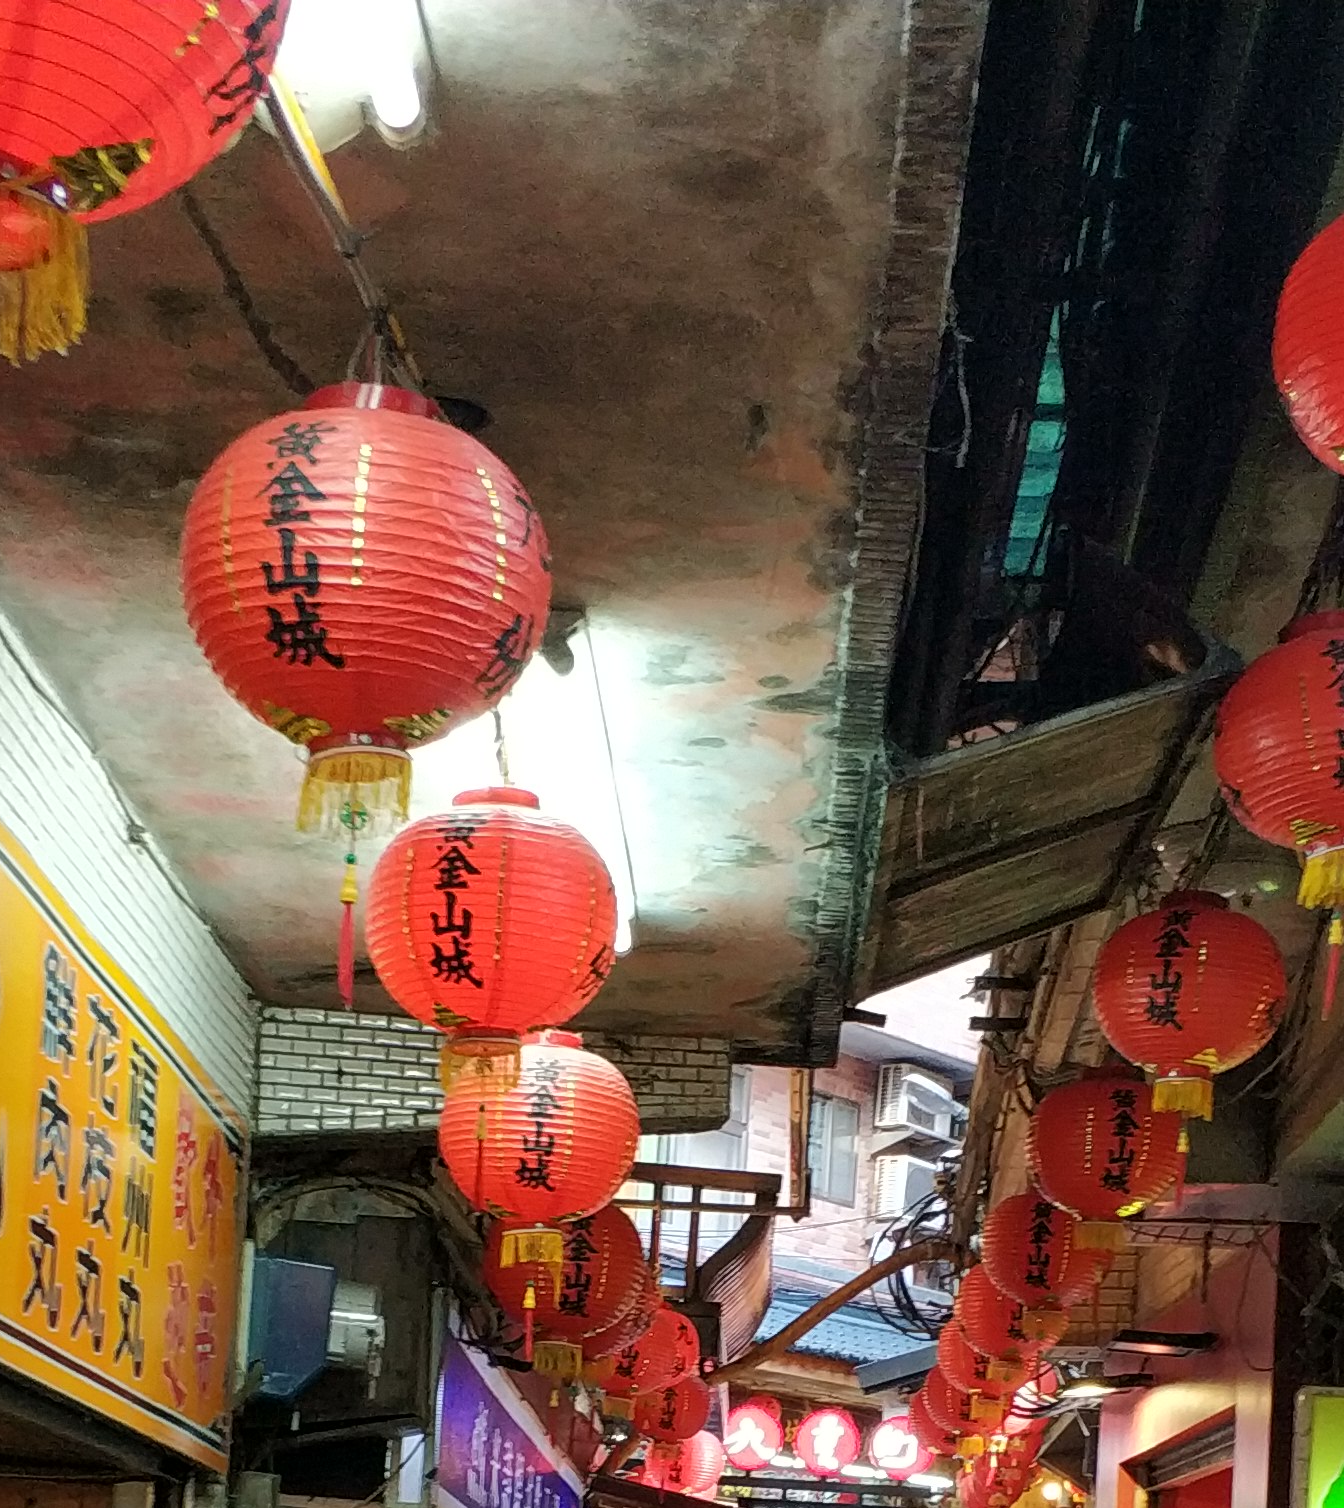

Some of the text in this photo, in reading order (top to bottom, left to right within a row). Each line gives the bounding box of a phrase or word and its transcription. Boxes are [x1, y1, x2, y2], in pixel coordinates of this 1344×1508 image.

[259, 421, 346, 669] 黃金山城
[429, 811, 484, 988] 黃金山城
[1146, 906, 1194, 1032] 黃金山城
[71, 994, 120, 1355] 花枝丸
[114, 1039, 160, 1380] 福州丸
[516, 1059, 566, 1191] 黃金山城
[1098, 1088, 1141, 1194] 黃金山城
